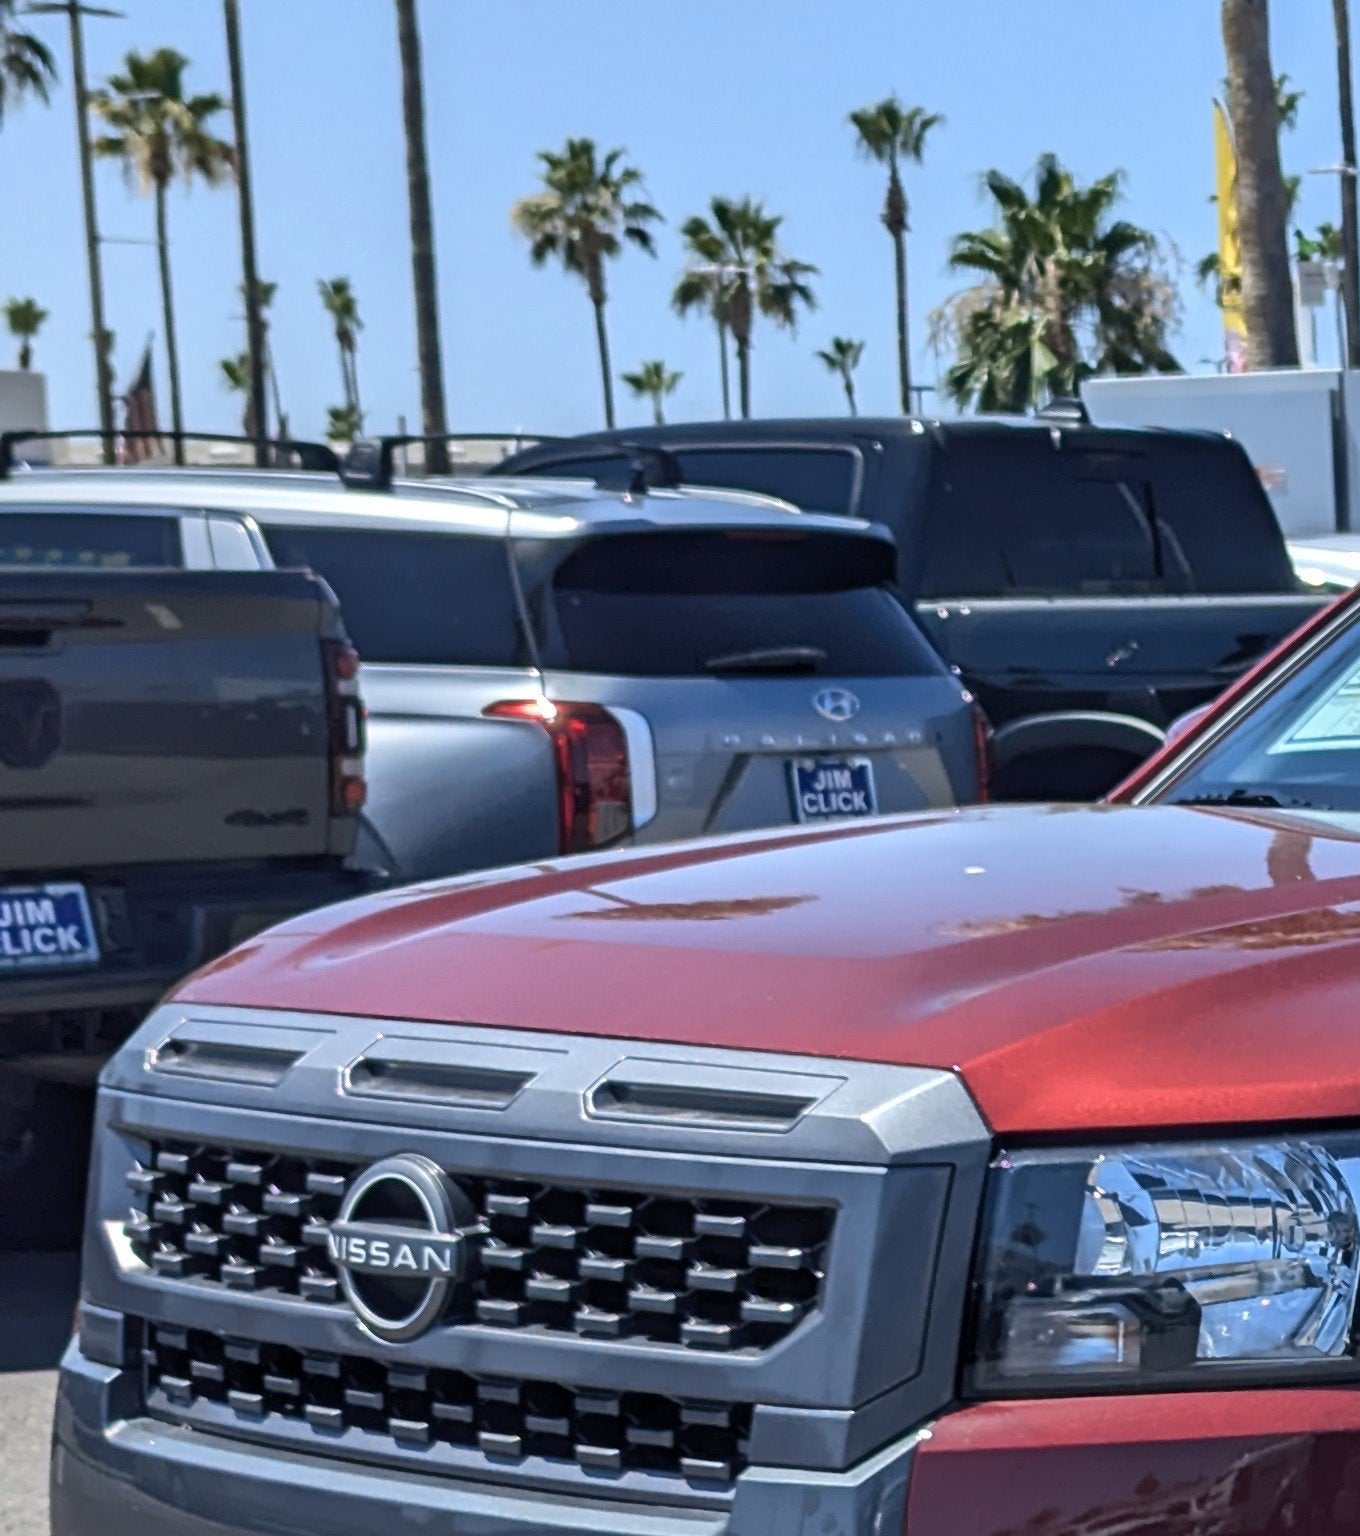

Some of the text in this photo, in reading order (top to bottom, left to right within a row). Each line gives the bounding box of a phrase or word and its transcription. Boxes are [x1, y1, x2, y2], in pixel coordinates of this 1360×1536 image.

[813, 769, 853, 791] JIM
[803, 791, 868, 815] CLICK
[0, 925, 83, 955] LICK
[327, 1234, 450, 1271] NISSAN
